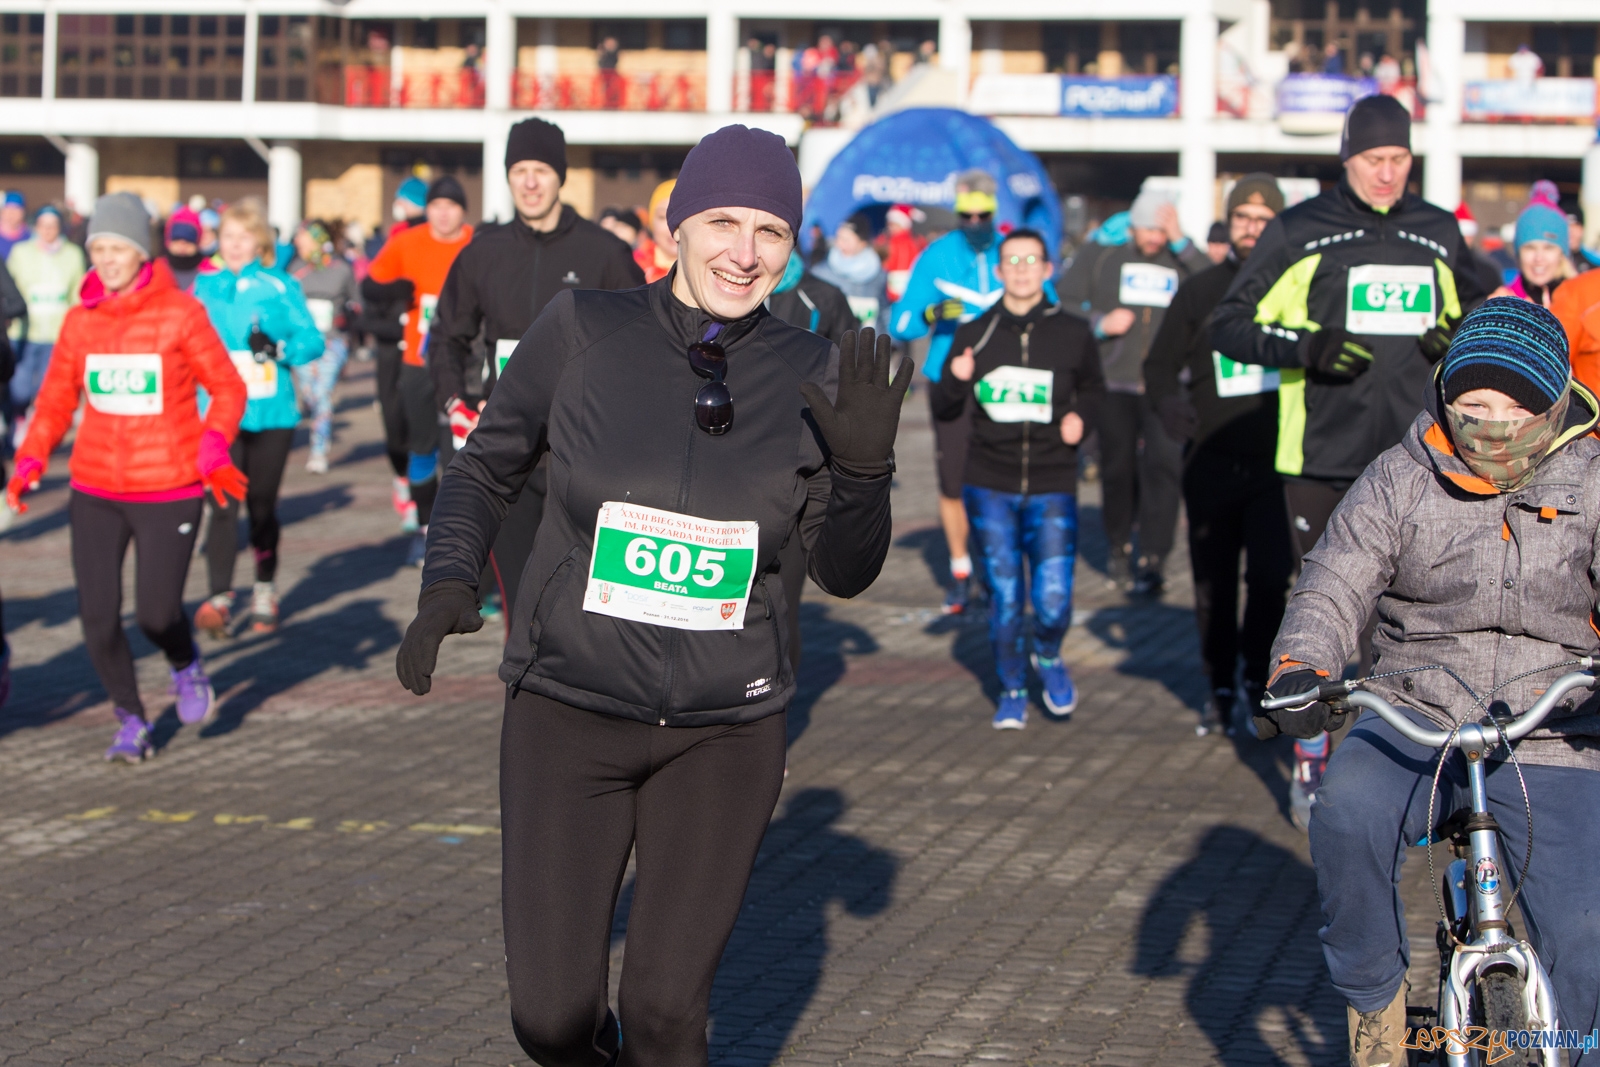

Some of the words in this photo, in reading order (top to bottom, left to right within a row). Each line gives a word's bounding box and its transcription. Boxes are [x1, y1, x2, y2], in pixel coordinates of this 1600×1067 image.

[1366, 282, 1420, 308] 627
[621, 509, 649, 522] XXXII
[651, 515, 675, 526] BIEG
[676, 520, 747, 535] SYLWESTROWY
[624, 521, 639, 531] IM.
[641, 524, 693, 541] RYSZARDA
[695, 536, 742, 546] BURGIELA
[624, 537, 727, 588] 605
[653, 580, 689, 595] BEATA
[1481, 869, 1495, 883] P
